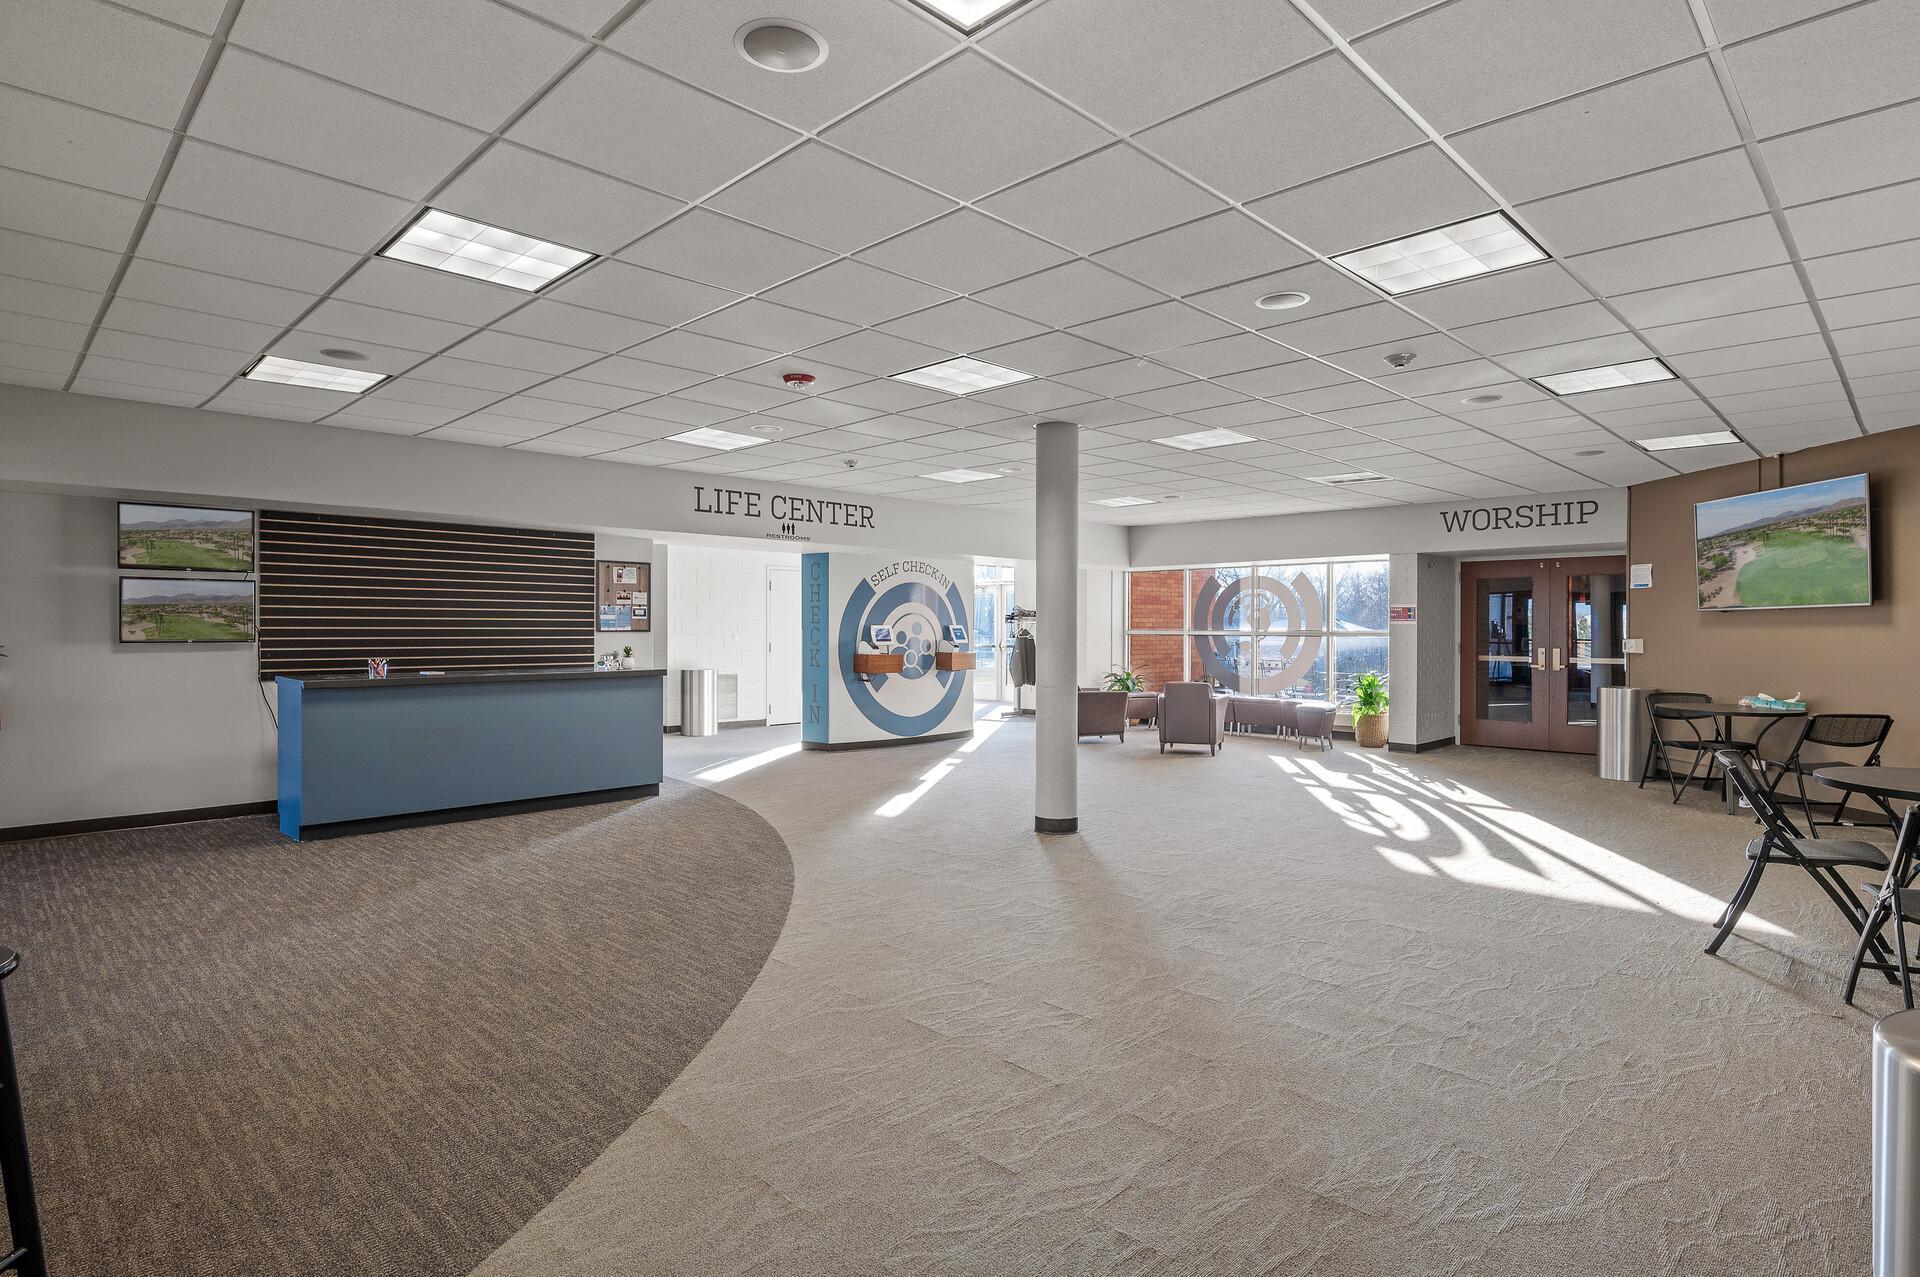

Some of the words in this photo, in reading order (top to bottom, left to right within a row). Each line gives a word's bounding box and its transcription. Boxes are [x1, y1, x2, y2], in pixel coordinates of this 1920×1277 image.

[694, 486, 761, 518] LIFE
[771, 495, 875, 529] CENTER
[1440, 500, 1599, 533] WORSHIP
[766, 533, 811, 542] RESTROOMS
[870, 562, 900, 587] SELF
[902, 561, 951, 590] CHECK-IN
[809, 562, 822, 668] CHECK
[809, 684, 822, 724] IN
